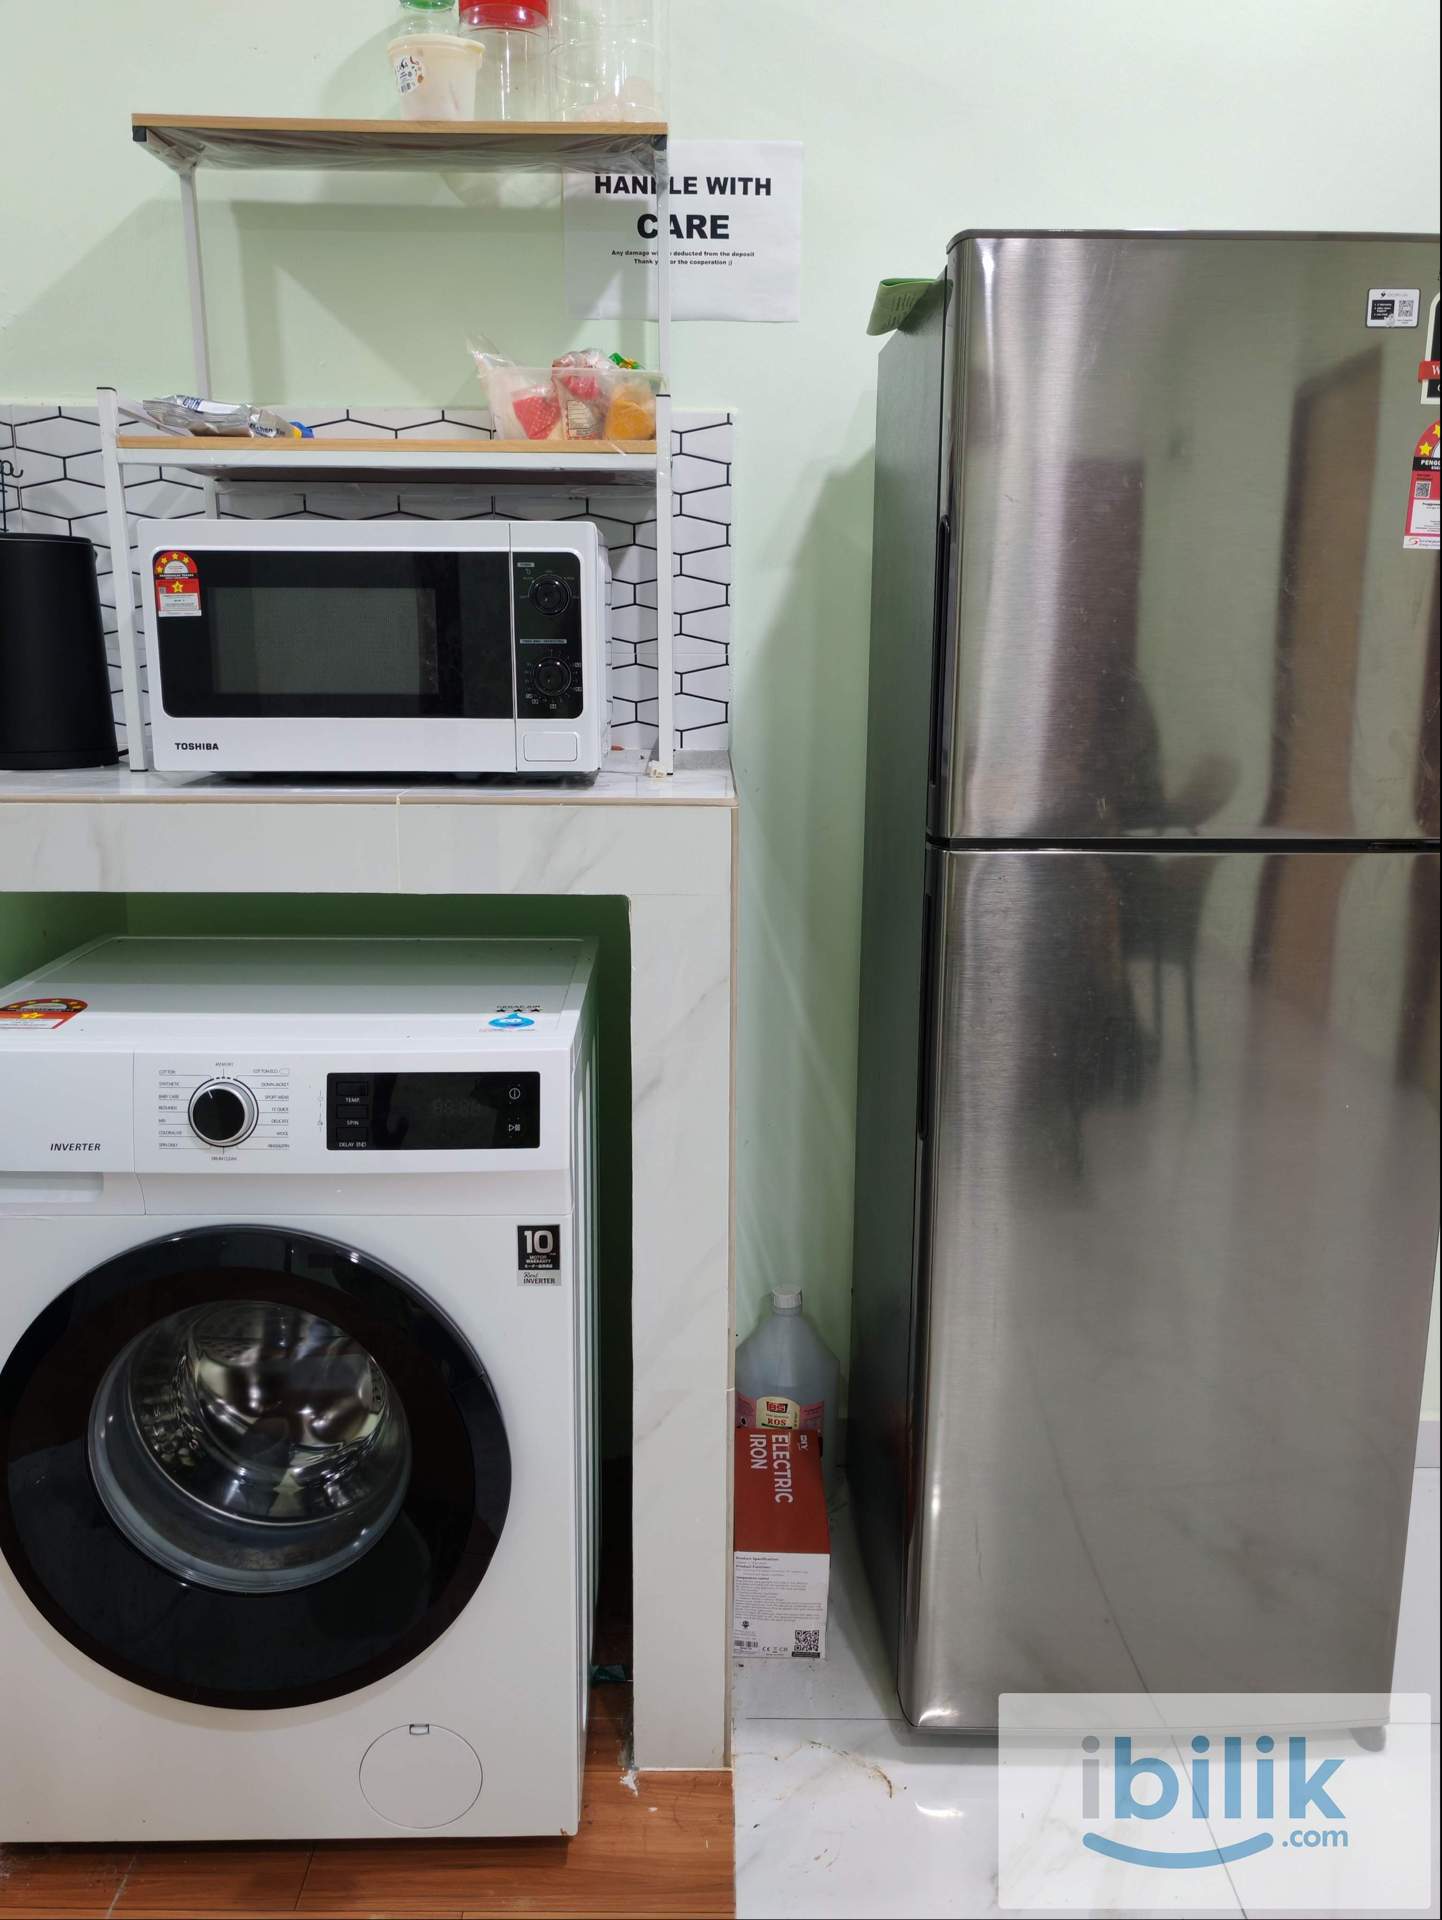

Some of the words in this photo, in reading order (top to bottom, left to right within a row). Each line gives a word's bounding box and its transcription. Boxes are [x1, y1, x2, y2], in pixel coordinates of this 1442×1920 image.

[706, 176, 772, 196] WITH
[637, 214, 730, 239] CARE
[174, 742, 219, 750] TOSHIBA
[50, 1143, 101, 1151] INVERTER
[524, 1230, 553, 1254] 10
[750, 1434, 768, 1469] IRON
[772, 1435, 794, 1503] ELECTRIC
